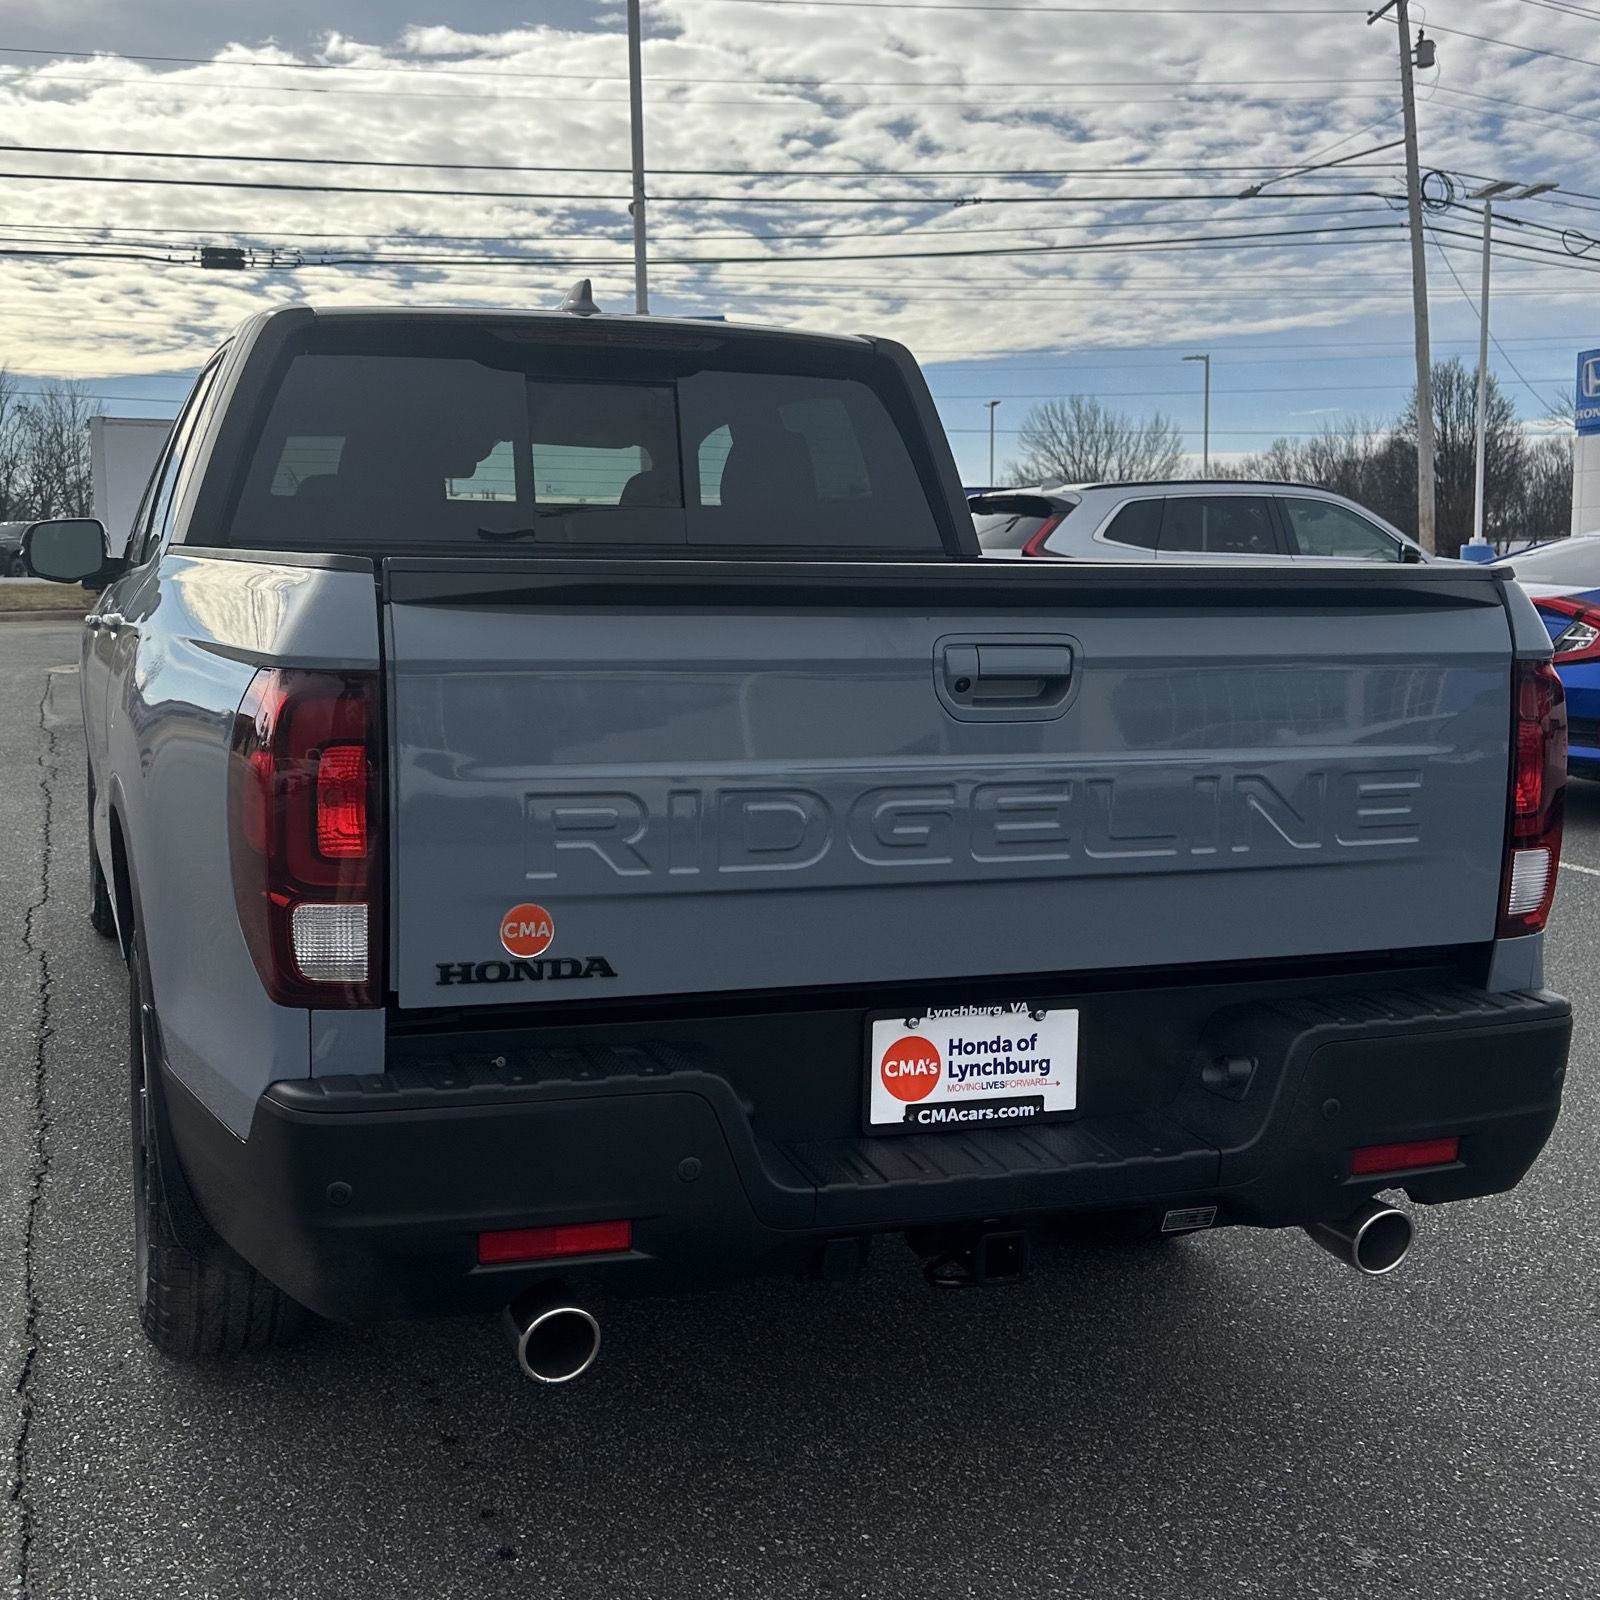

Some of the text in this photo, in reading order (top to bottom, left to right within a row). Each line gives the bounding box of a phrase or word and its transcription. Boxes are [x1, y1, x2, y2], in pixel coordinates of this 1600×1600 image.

[525, 770, 1423, 881] RIDGELINE
[503, 921, 550, 939] CMA
[435, 956, 618, 986] HONDA
[926, 1002, 1029, 1019] Lynchburg, VA
[948, 1033, 1038, 1056] Honda of
[884, 1058, 938, 1077] CMA's
[948, 1057, 1051, 1082] Lynchburg
[917, 1104, 1035, 1124] CMAcars.com
